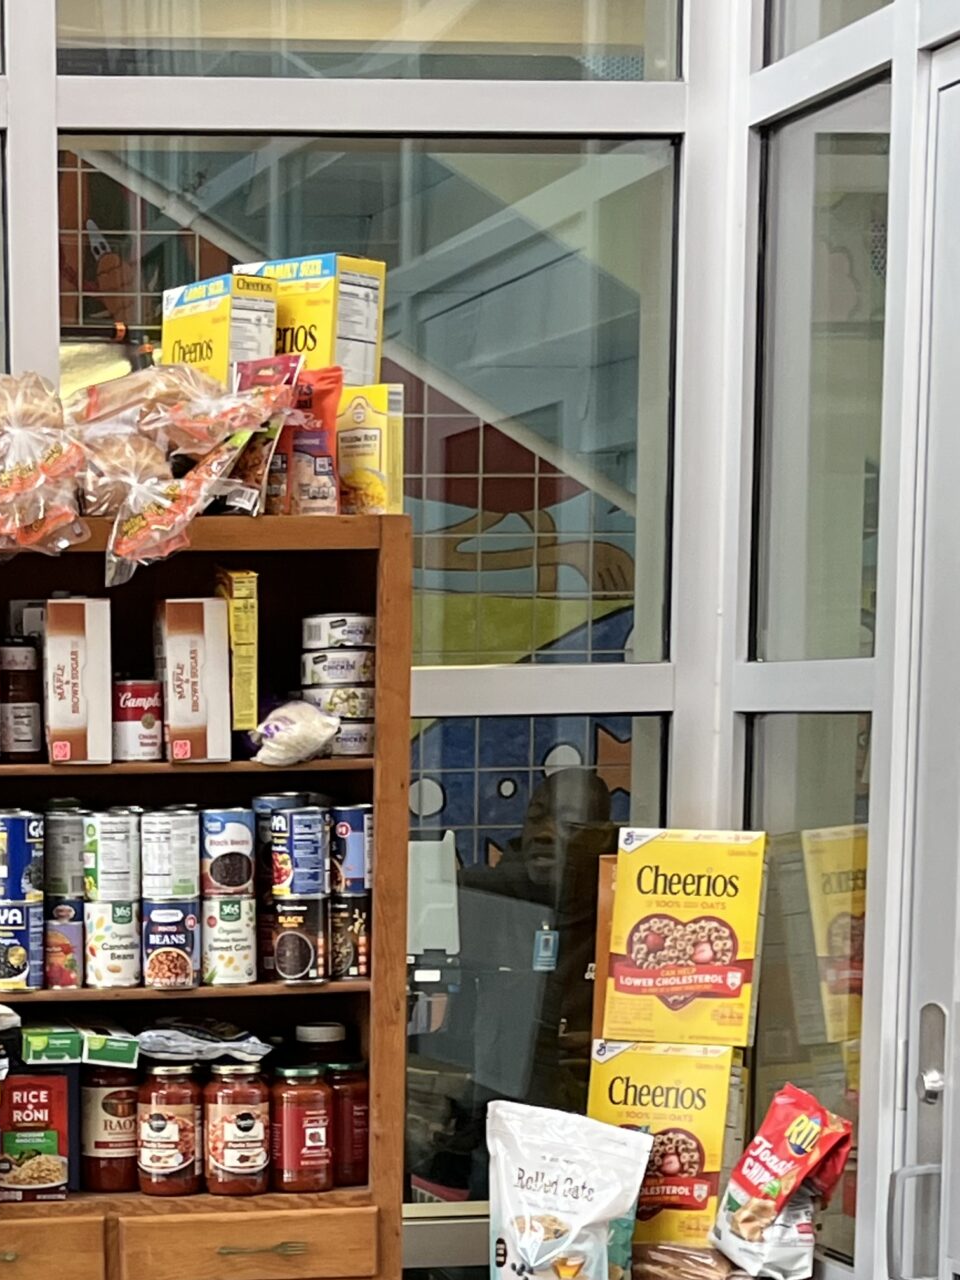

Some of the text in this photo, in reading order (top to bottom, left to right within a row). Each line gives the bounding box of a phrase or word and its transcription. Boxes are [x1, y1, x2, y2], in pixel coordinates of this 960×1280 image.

[236, 278, 273, 292] Cheerios
[172, 339, 214, 363] Cheerios
[636, 865, 740, 897] Cheerios
[221, 905, 240, 915] 365
[655, 900, 727, 910] 100% OATS
[114, 907, 130, 916] 365
[278, 915, 304, 923] BLACK
[149, 934, 186, 945] BEANS
[208, 943, 252, 952] Sweet Corn
[660, 967, 696, 977] CAN HELP
[619, 974, 724, 987] LOWER CHOLESTEROL
[12, 1091, 49, 1104] RICE
[608, 1076, 707, 1111] Cheerios
[12, 1109, 49, 1122] RONI
[625, 1110, 694, 1122] 100% OATS
